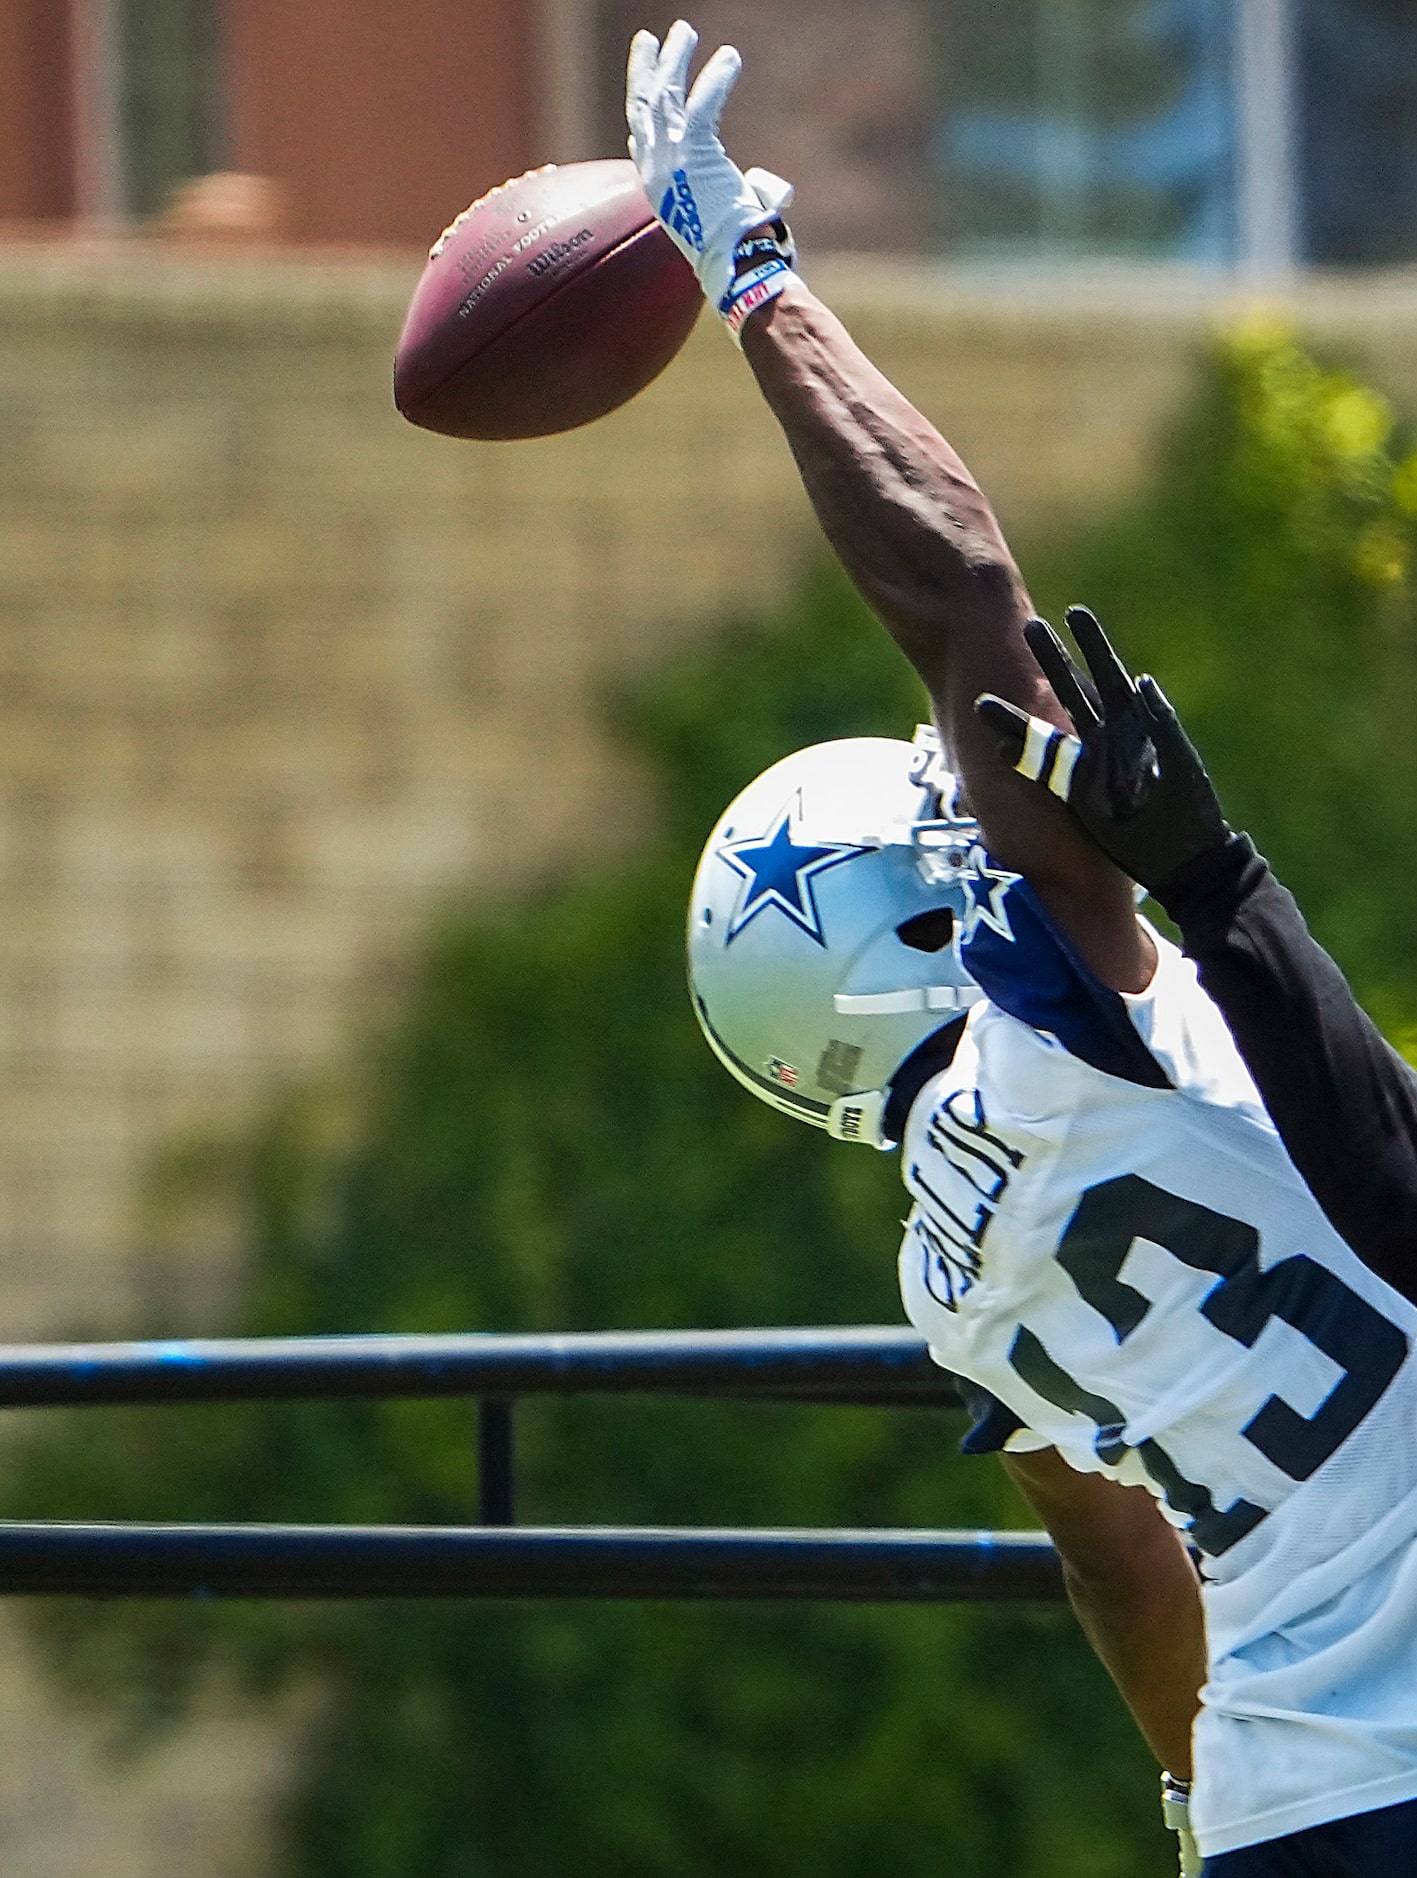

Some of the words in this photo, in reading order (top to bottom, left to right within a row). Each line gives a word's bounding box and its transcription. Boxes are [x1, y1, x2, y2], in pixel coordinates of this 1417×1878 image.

[525, 229, 595, 277] Wilson
[459, 256, 513, 318] NATIONAL
[1008, 1173, 1411, 1558] 13
